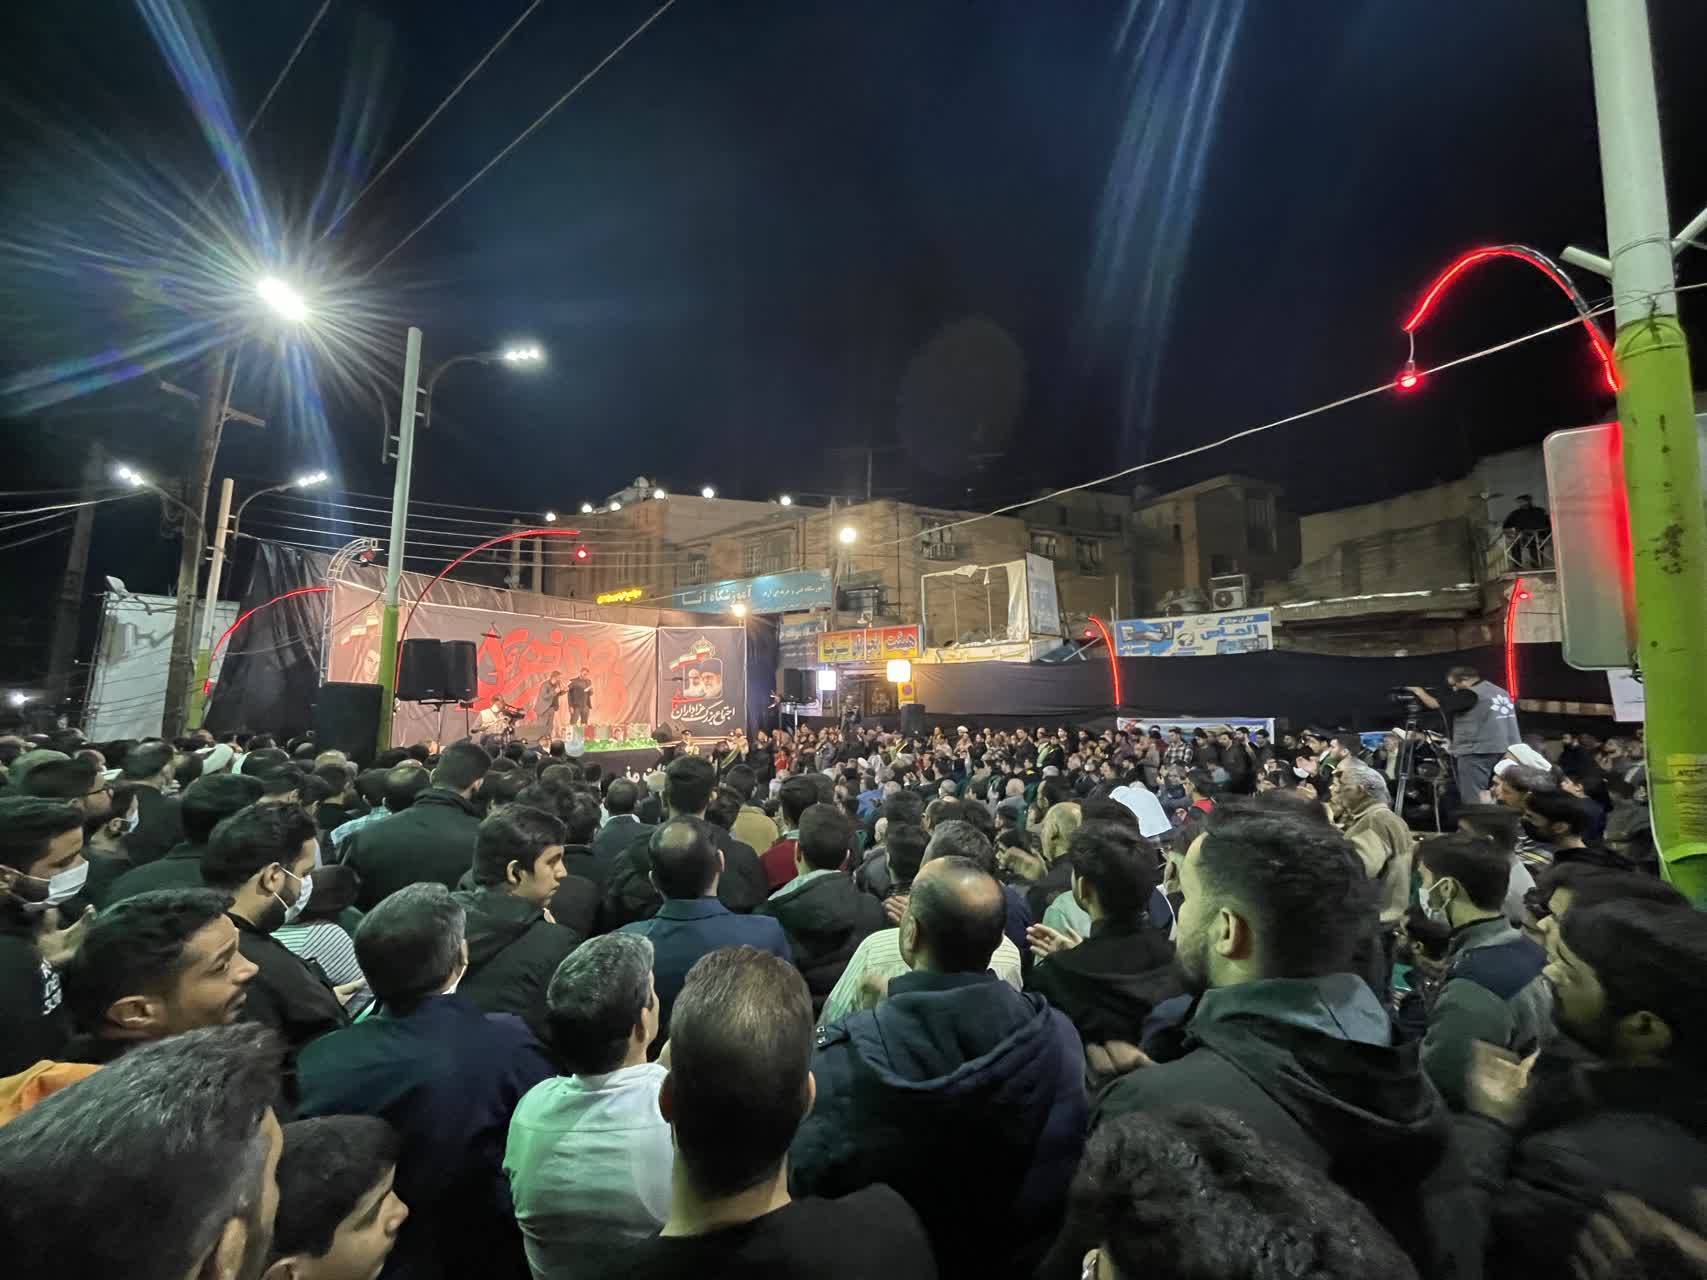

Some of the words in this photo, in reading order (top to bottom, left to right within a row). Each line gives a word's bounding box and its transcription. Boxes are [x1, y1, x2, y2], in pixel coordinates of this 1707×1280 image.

[709, 584, 752, 604] آموزشگاه
[671, 703, 706, 720] عزاداران
[712, 705, 736, 726] اجتماع
